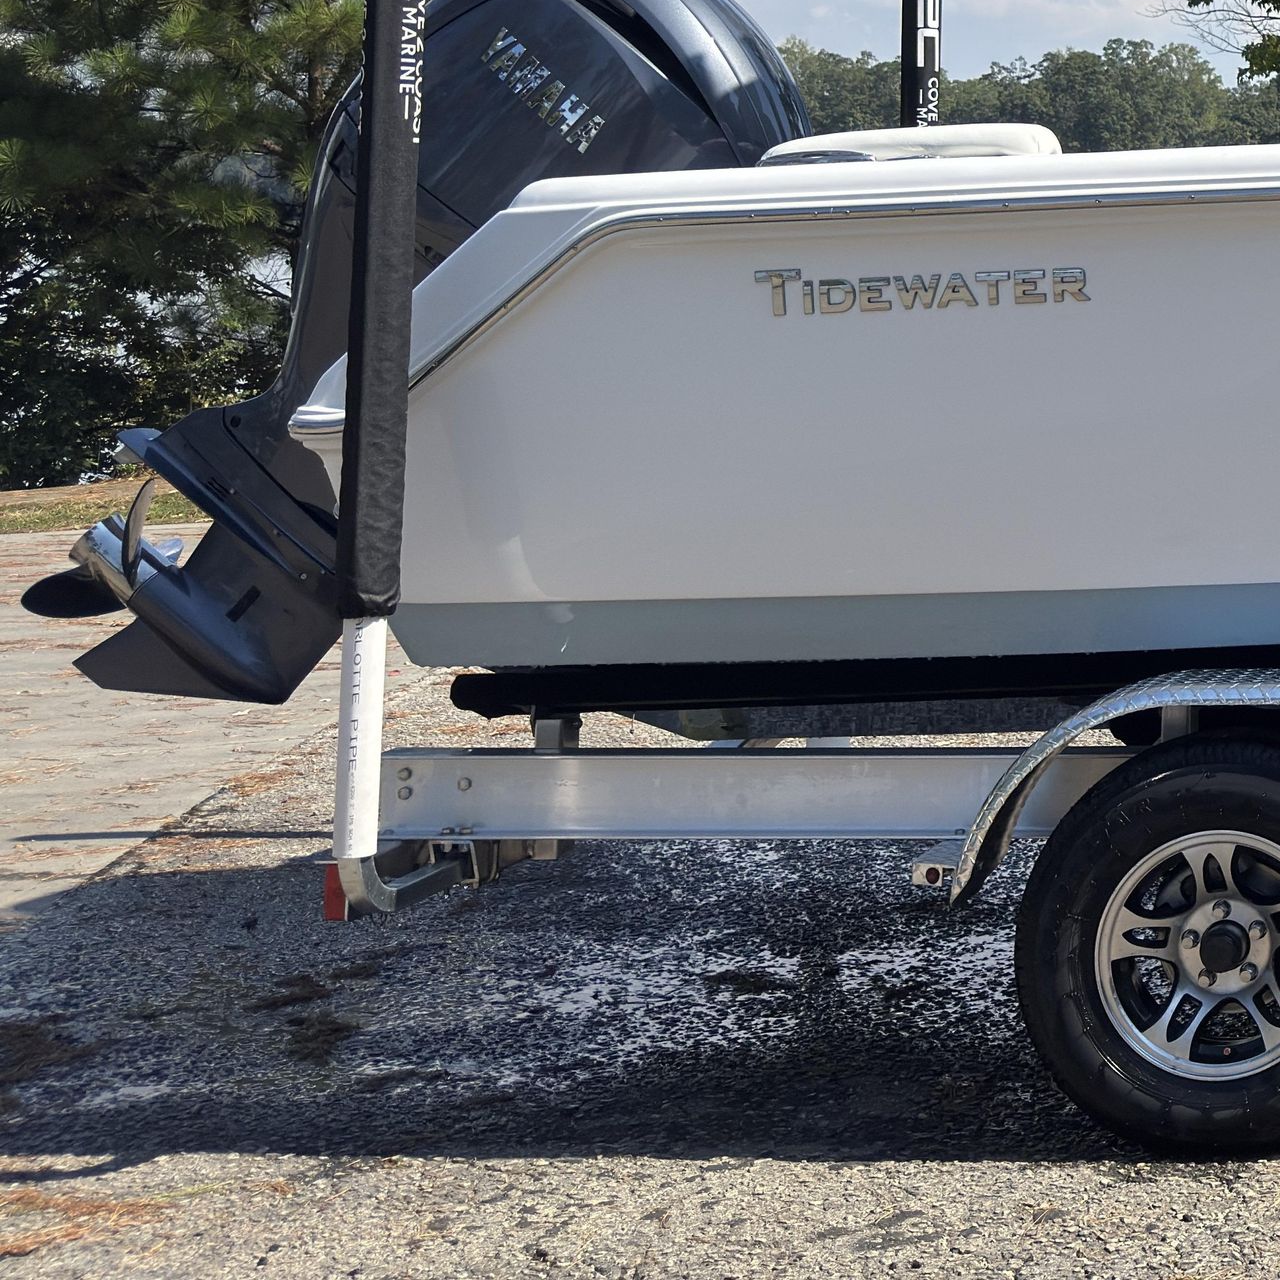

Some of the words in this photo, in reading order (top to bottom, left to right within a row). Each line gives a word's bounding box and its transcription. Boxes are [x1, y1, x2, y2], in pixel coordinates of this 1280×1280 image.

[399, 7, 418, 94] MARINE
[481, 26, 606, 154] YAMAHA
[927, 77, 939, 122] COVE
[753, 267, 1091, 317] TIDEWATER
[347, 719, 359, 771] PIPE
